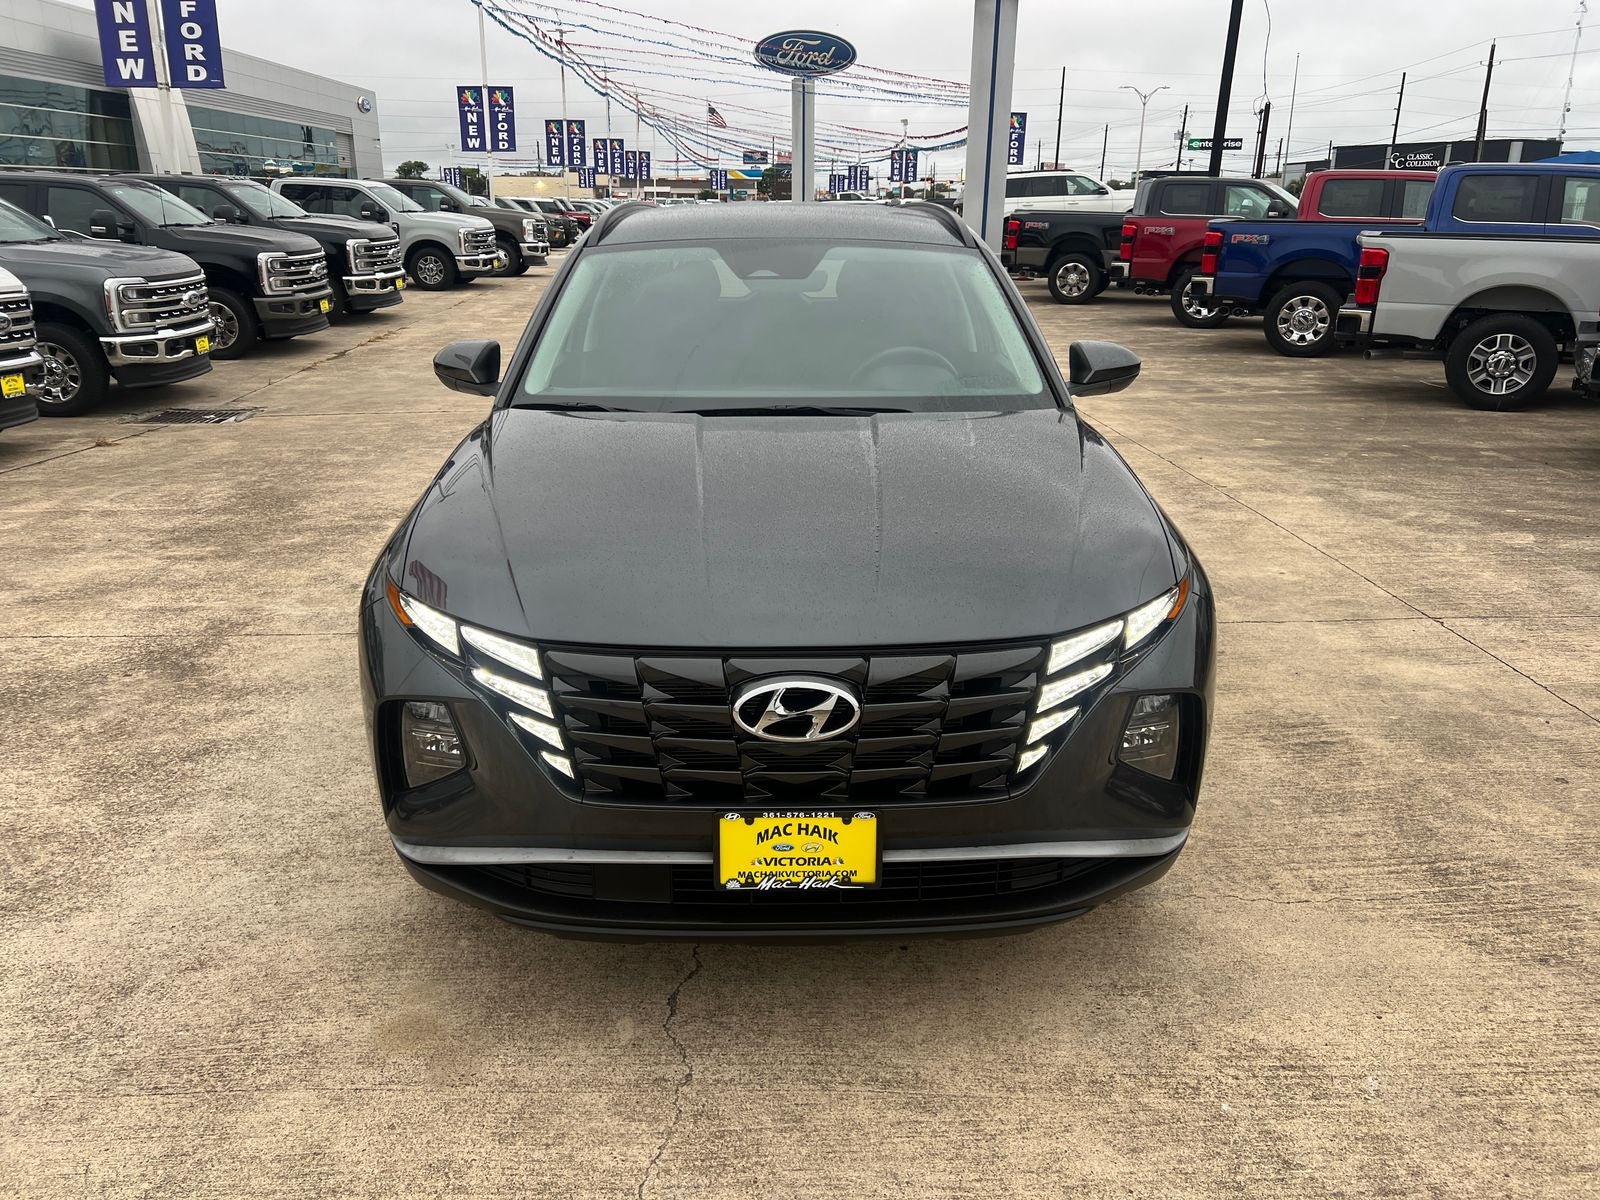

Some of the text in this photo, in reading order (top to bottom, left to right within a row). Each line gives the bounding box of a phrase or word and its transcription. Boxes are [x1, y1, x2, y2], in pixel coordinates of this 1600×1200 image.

[113, 1, 144, 80] NEW
[180, 1, 208, 82] FORD
[776, 38, 836, 66] Ford
[467, 112, 480, 149] NEW
[497, 113, 509, 150] FORD
[551, 138, 561, 164] NEW
[573, 138, 581, 165] FORD
[1009, 133, 1019, 163] FORD
[1406, 153, 1434, 161] CLASSIC
[597, 152, 606, 173] NEW
[893, 162, 901, 181] NEW
[1024, 221, 1050, 230] FX4
[1143, 226, 1176, 236] FX4
[1231, 233, 1270, 245] FX4
[756, 822, 839, 846] MAC HAIK
[763, 857, 832, 867] VICTORIA
[737, 869, 858, 879] MACHAIKVICTORIA.COM
[756, 875, 842, 891] Mac Haik
